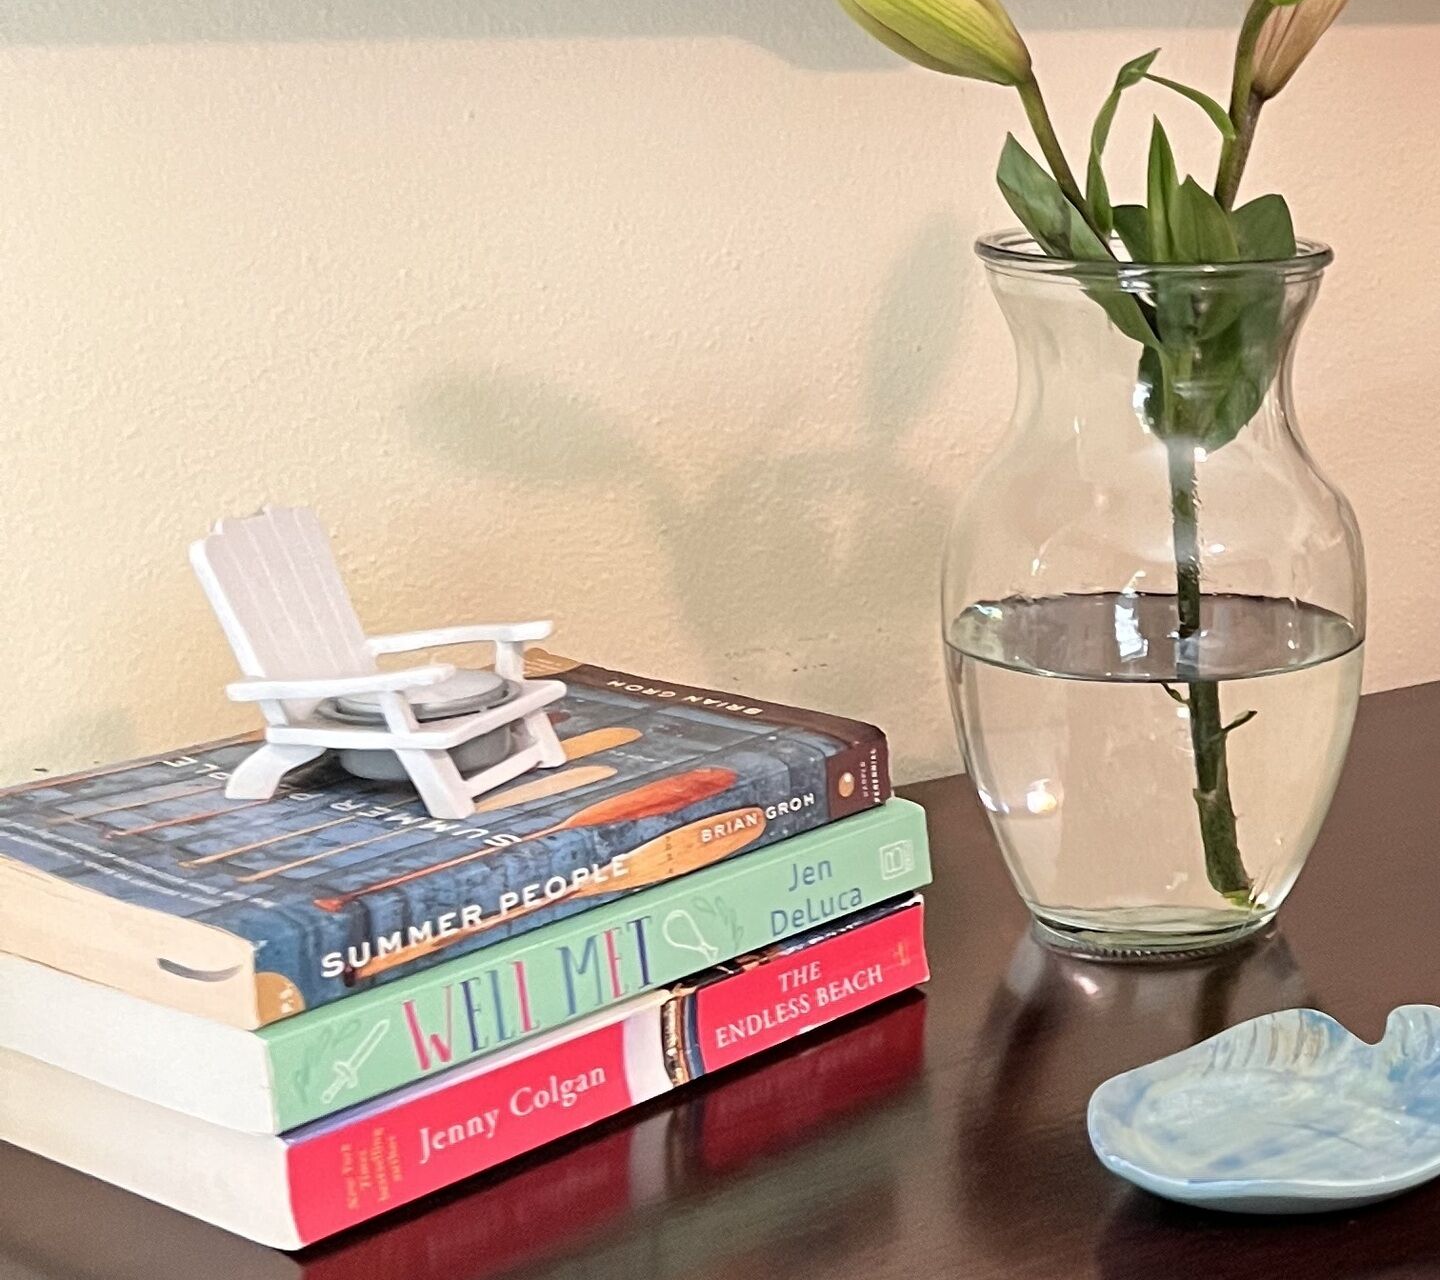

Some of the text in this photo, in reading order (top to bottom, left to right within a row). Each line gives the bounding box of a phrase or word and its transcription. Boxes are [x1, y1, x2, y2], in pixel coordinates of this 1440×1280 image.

[606, 678, 763, 716] BRIAN GROH
[329, 799, 523, 848] SUMMER
[700, 792, 816, 844] BRIAN GROH
[788, 859, 833, 892] Jen
[320, 903, 484, 978] SUMMER
[500, 852, 630, 916] PEOPLE
[770, 886, 863, 937] DeLuca
[402, 915, 652, 1071] WELL MET
[777, 960, 822, 993] THE
[714, 963, 884, 1049] ENDLESS BEACH
[419, 1065, 607, 1164] Jenny Colgan
